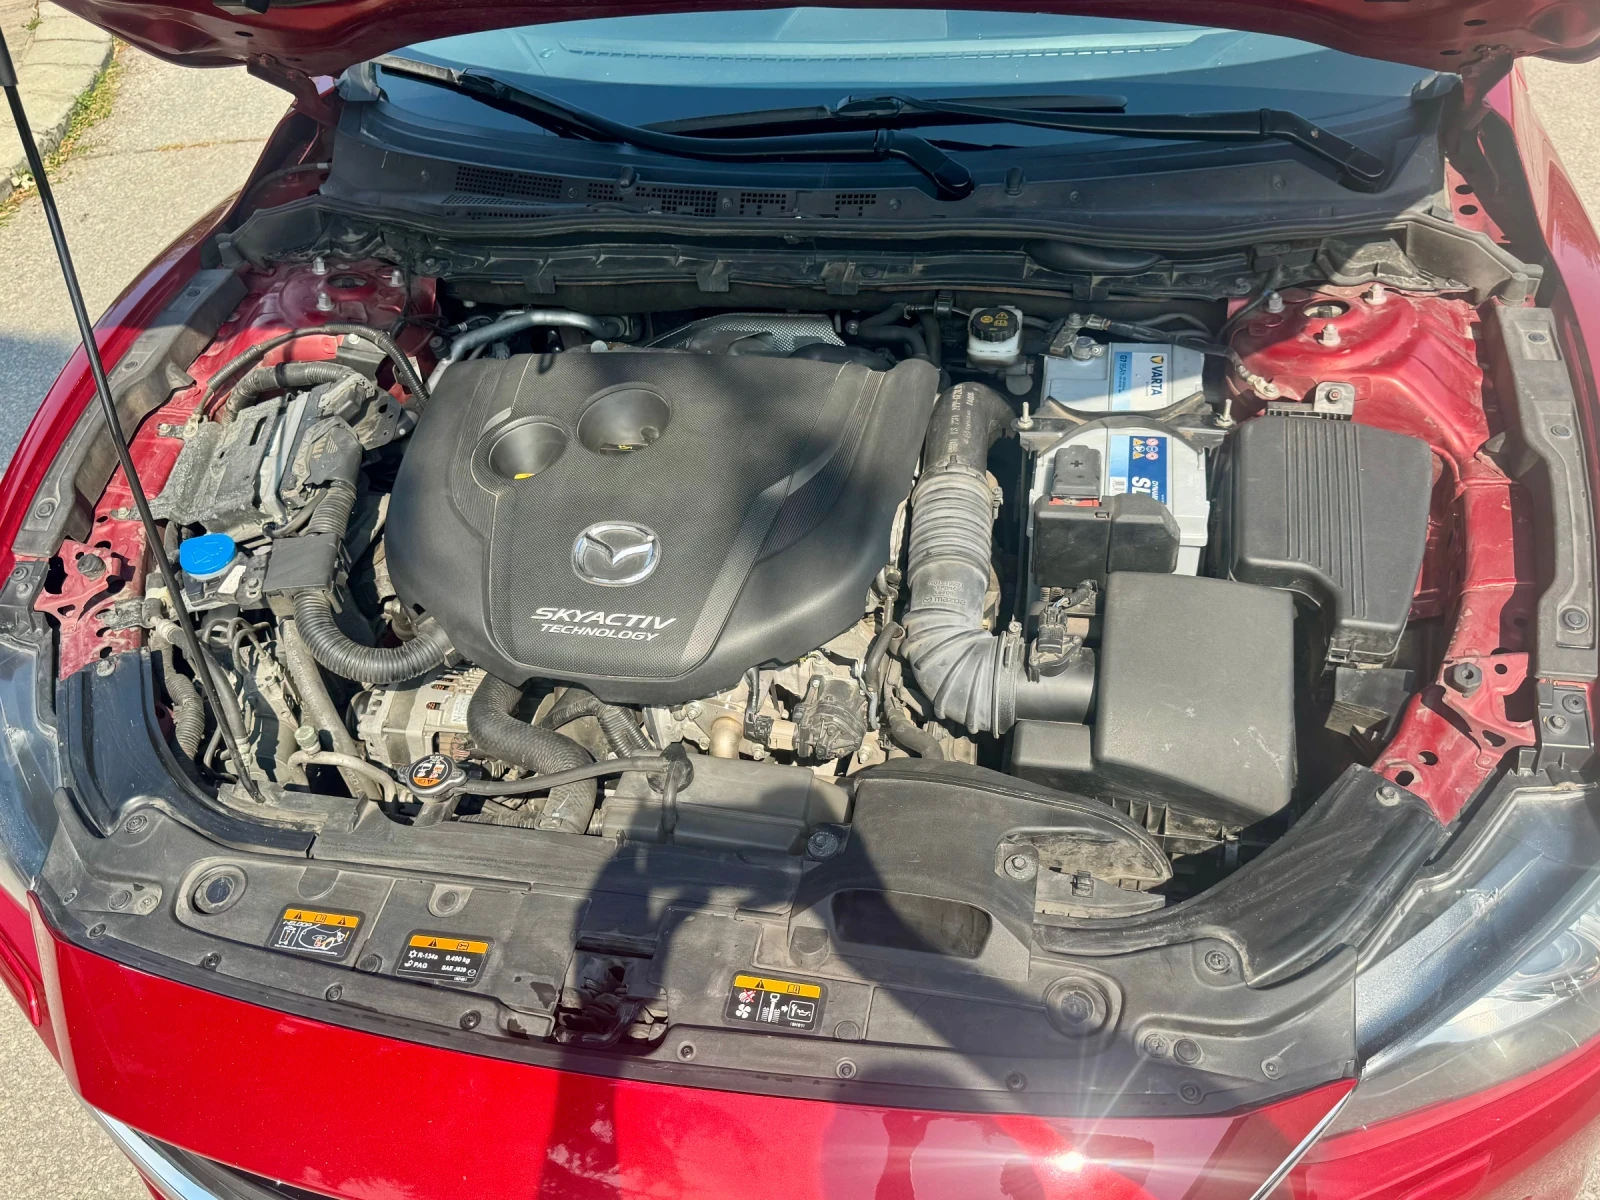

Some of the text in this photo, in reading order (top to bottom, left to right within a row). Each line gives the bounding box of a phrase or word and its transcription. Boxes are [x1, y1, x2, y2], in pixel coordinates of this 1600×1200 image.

[1119, 354, 1127, 363] G7
[1151, 365, 1163, 396] VARTA
[531, 607, 677, 630] SKYACTIV
[540, 623, 660, 642] TECHNOLOGY
[413, 960, 428, 969] PAG
[441, 964, 454, 972] SAE
[416, 951, 439, 960] R-134a
[461, 956, 471, 965] kg
